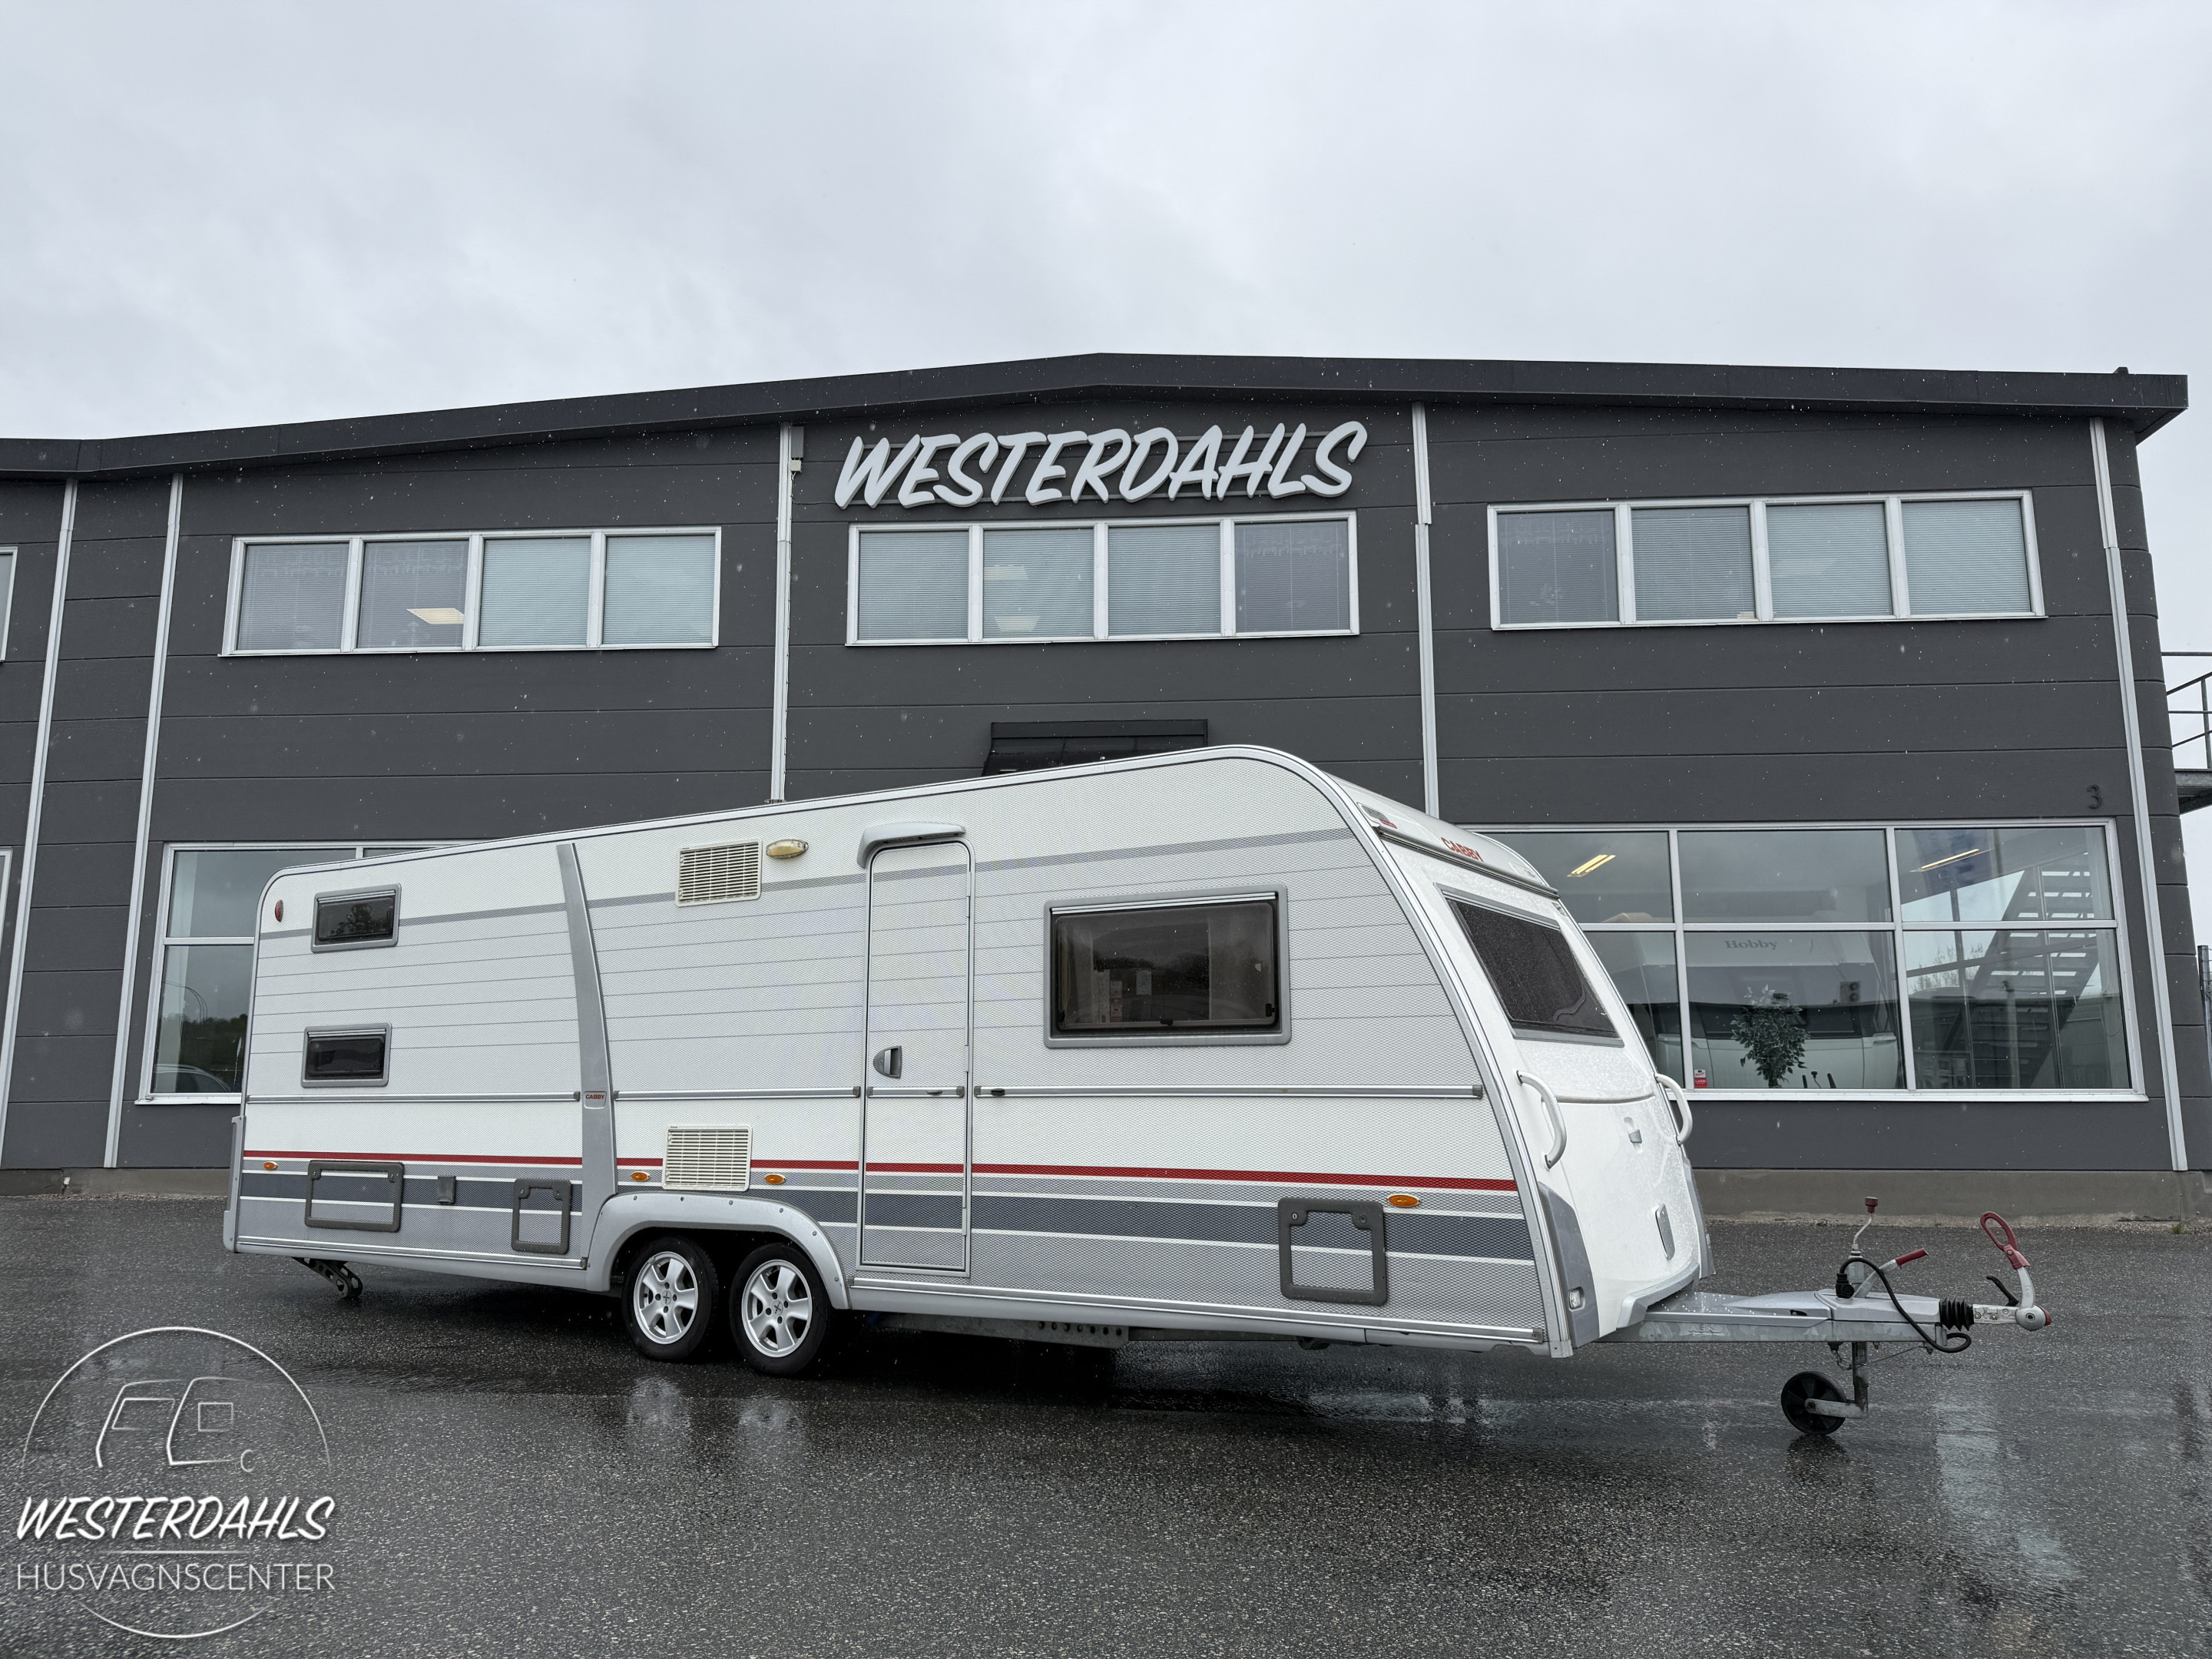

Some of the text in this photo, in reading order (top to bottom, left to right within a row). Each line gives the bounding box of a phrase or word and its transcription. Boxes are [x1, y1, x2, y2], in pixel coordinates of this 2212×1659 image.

[835, 421, 1367, 508] WESTERDAHLS
[2087, 785, 2102, 809] 3
[1441, 837, 1484, 862] CABBY
[1725, 939, 1777, 950] Hobby
